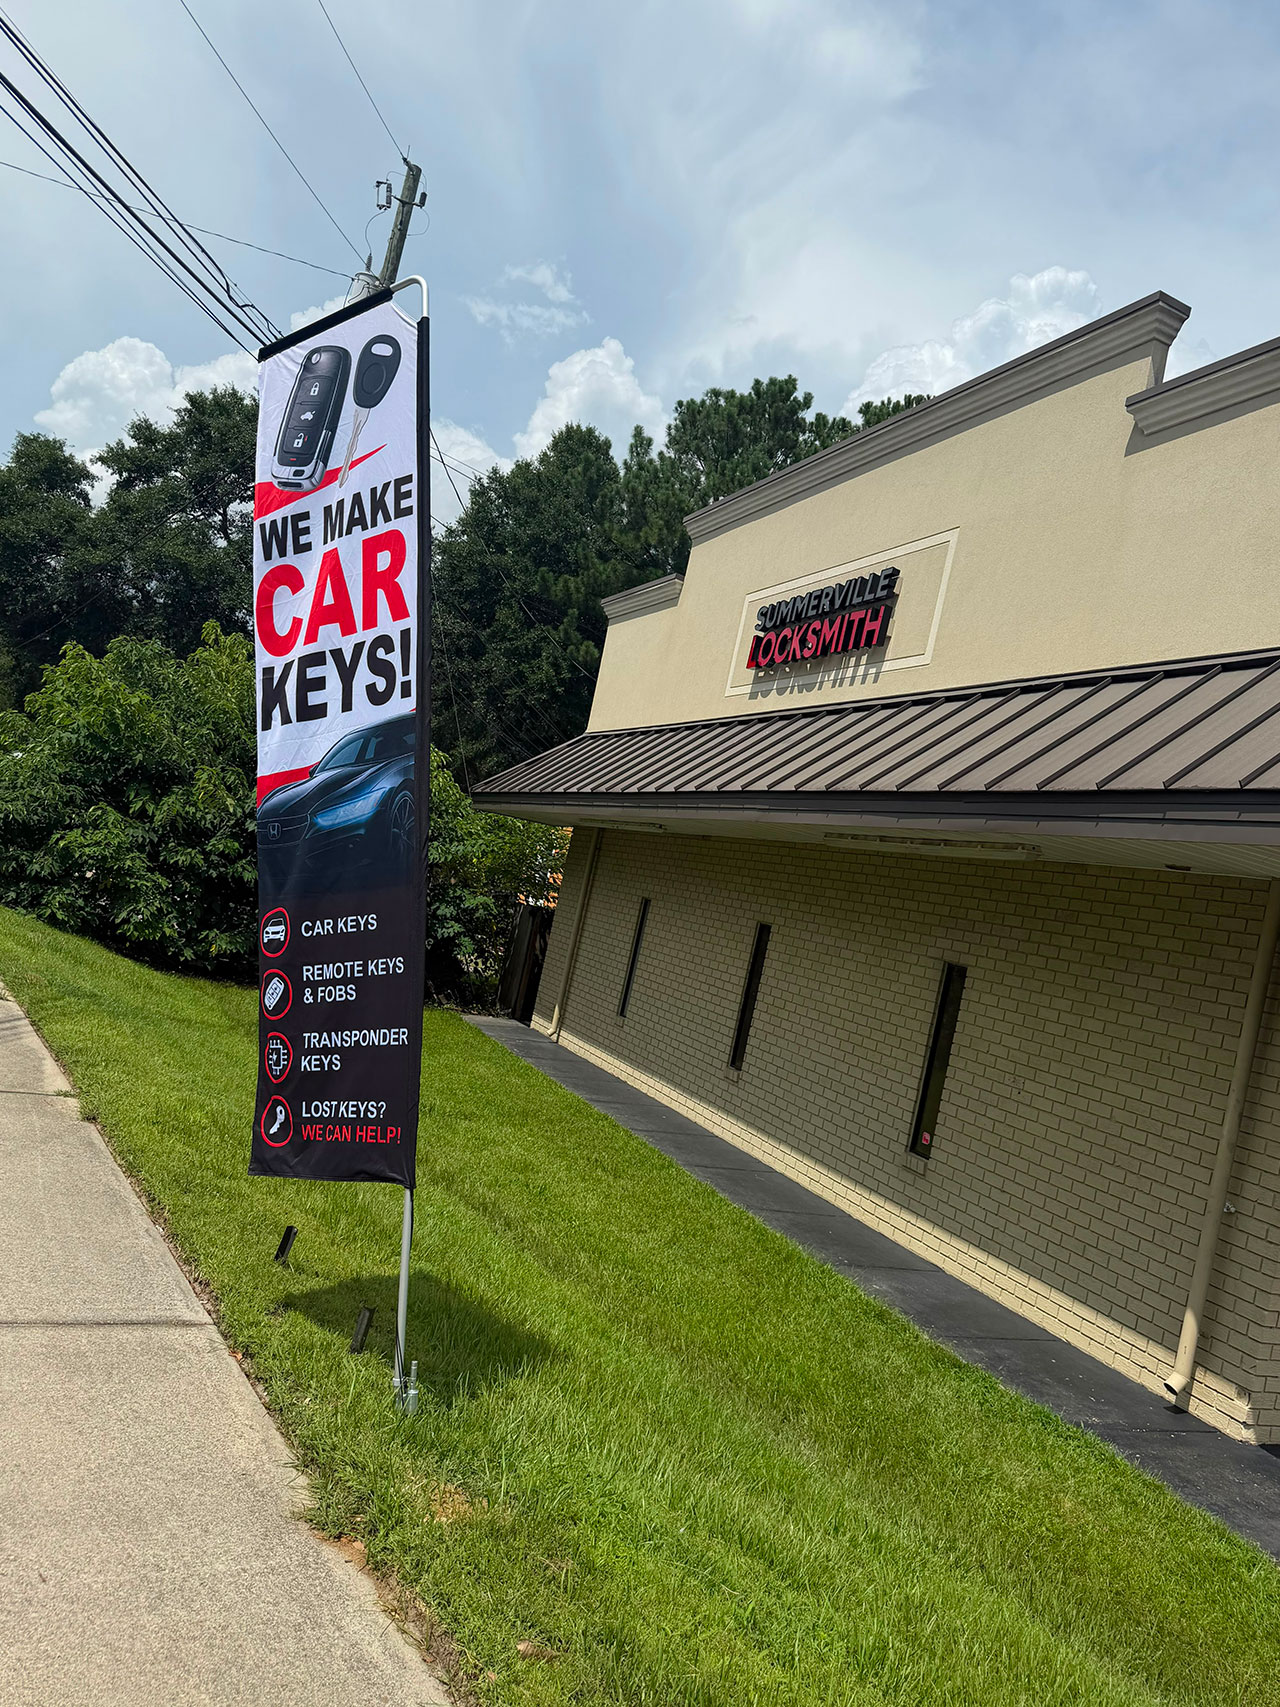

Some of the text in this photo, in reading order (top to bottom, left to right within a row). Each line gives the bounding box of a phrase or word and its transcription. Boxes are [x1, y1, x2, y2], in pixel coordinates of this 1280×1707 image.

[259, 474, 414, 561] WE MAKE
[255, 528, 410, 657] CAR
[755, 566, 898, 631] SUMMERVILLE
[746, 605, 888, 670] LOCKSMITH
[261, 627, 412, 731] KEYS!
[301, 914, 377, 937] CAR KEYS
[303, 957, 404, 982] REMOTE KEYS
[303, 984, 356, 1004] & FOBS
[303, 1028, 408, 1049] TRANSPONDER
[301, 1054, 341, 1072] KEYS
[302, 1101, 386, 1119] LOST KEYS?
[301, 1124, 401, 1144] WE CAN HELP!
